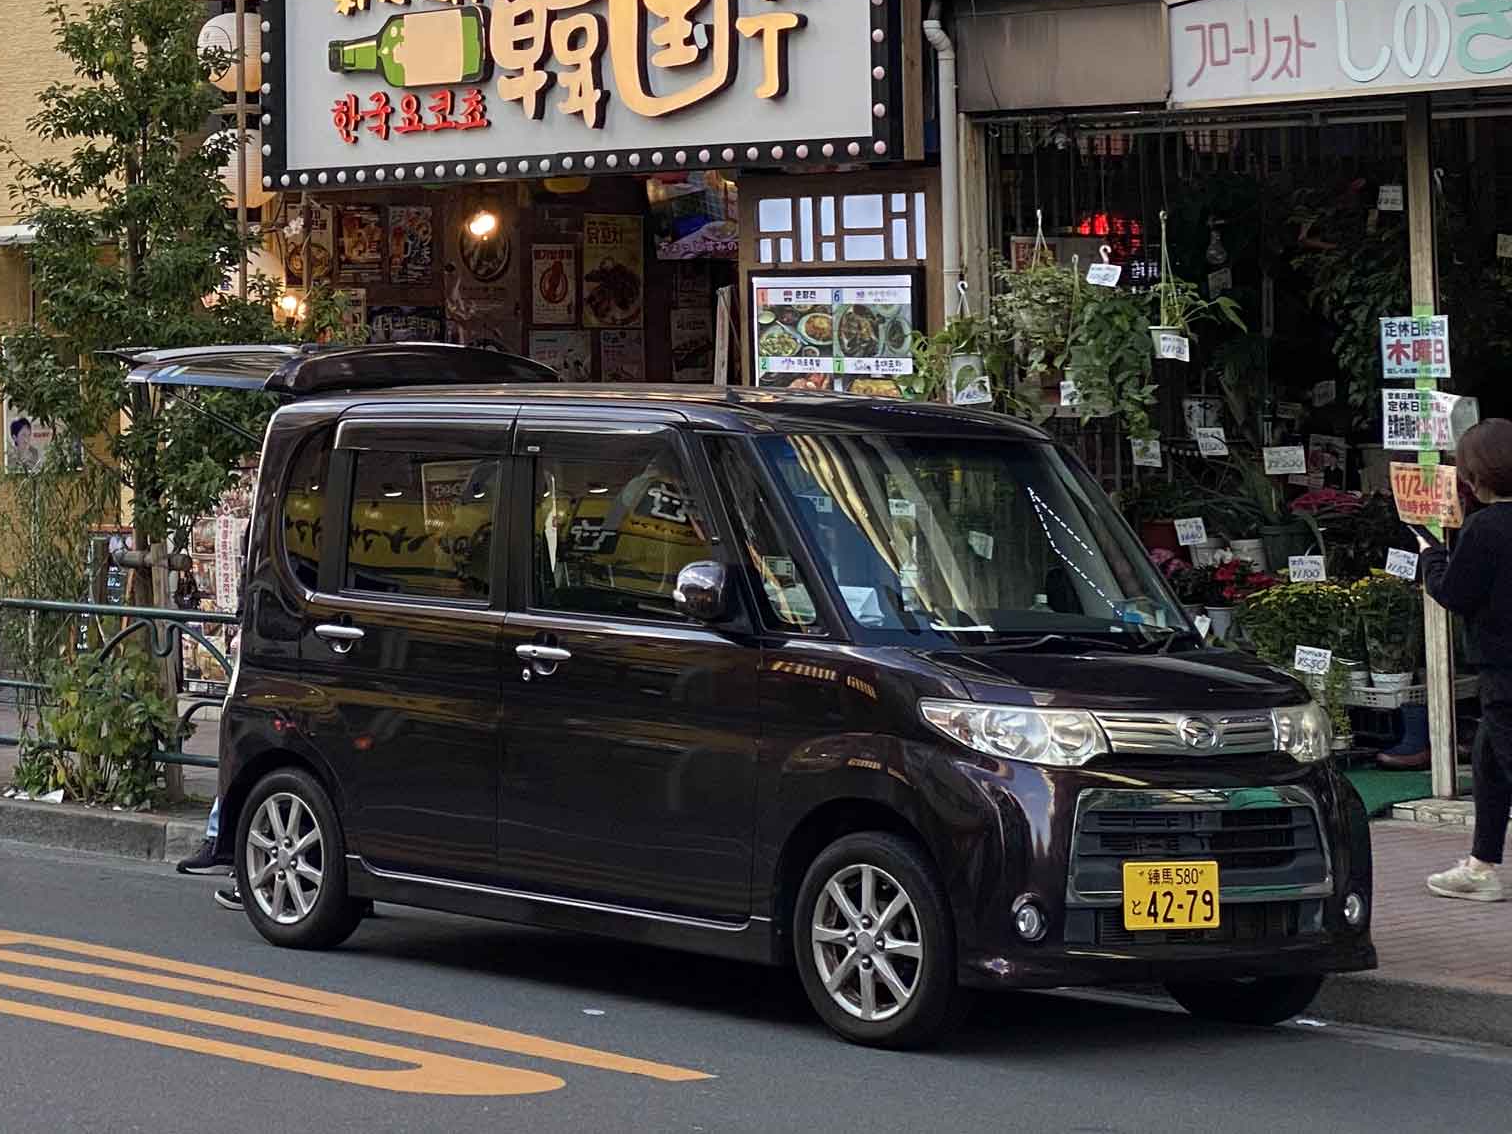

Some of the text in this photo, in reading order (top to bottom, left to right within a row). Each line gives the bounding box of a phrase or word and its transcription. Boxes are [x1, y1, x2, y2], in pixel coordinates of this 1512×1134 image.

[1185, 13, 1316, 87] フローリスト
[1147, 867, 1199, 885] 練馬 580
[1130, 889, 1215, 924] と 42-79
